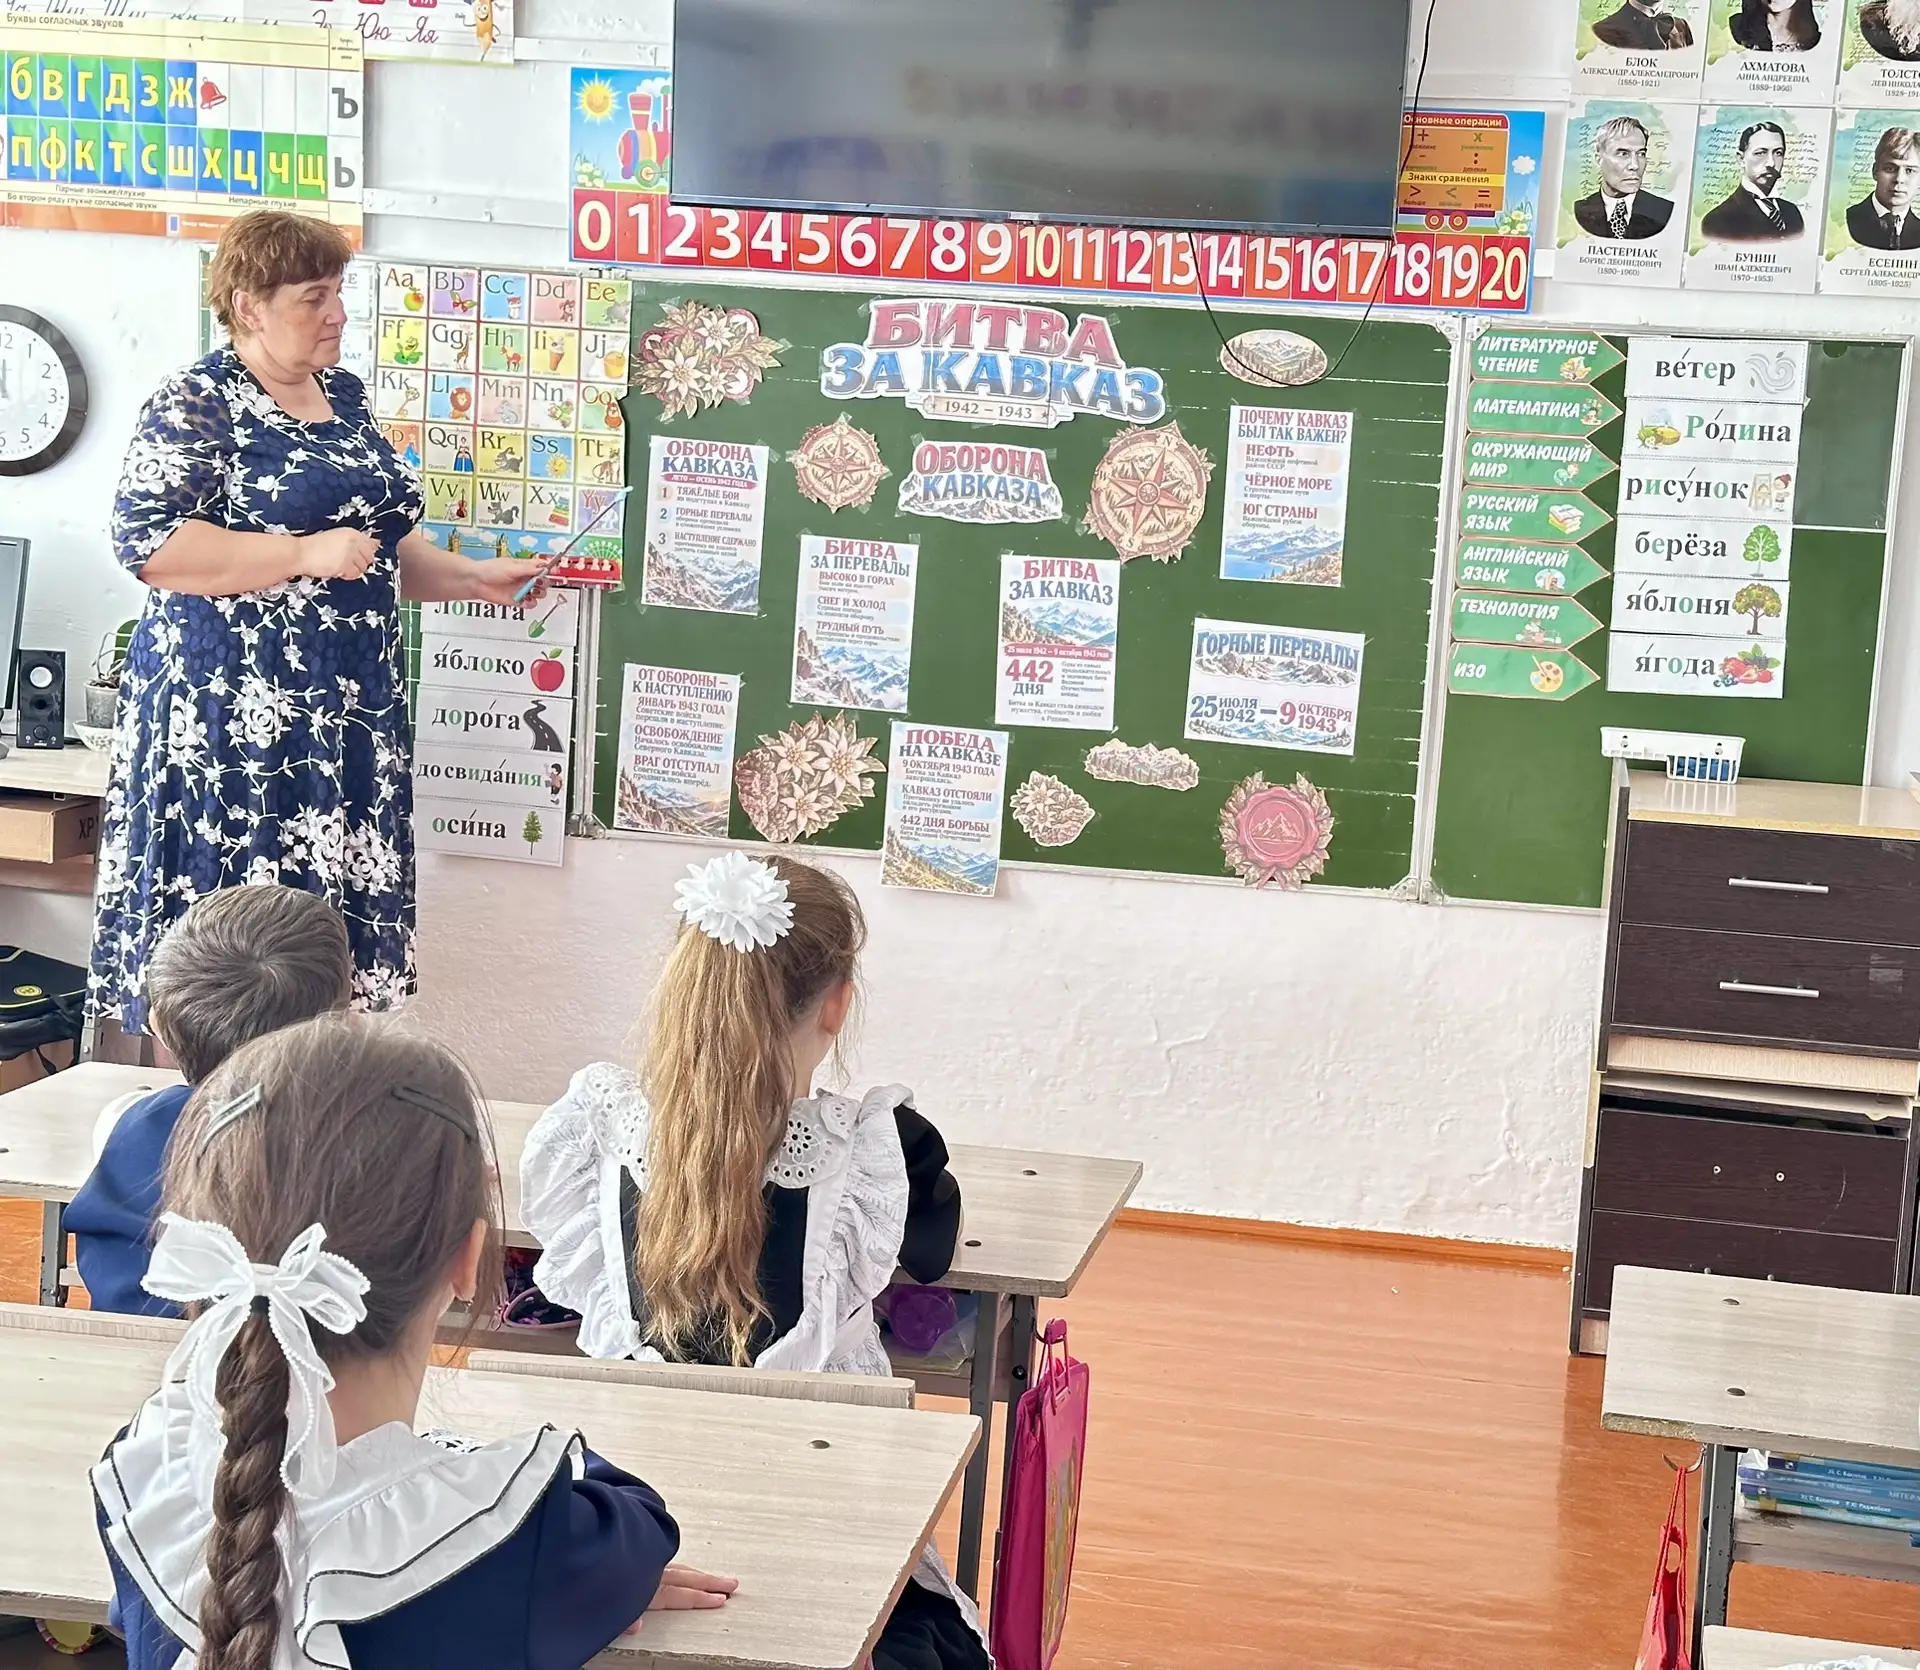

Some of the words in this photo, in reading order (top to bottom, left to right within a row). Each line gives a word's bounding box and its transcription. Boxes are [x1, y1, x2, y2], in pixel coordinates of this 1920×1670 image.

[7, 13, 37, 24] Буквы
[38, 15, 89, 26] согласных
[90, 18, 124, 30] звуков
[354, 12, 392, 40] Юю
[406, 15, 440, 45] Яя
[1624, 56, 1658, 68] БЛОК
[1739, 61, 1806, 74] АХМАТОВА
[1581, 68, 1628, 78] АЛЕКСАНДР
[1628, 69, 1700, 81] АЛЕКСАНДРОВИЧ
[1736, 72, 1758, 81] АННА
[1758, 73, 1810, 83] АНДРЕЕВНА
[1403, 114, 1453, 126] Оновные
[1454, 118, 1502, 128] операции
[1408, 172, 1437, 182] Знаки
[1438, 174, 1490, 184] сравнения
[577, 200, 612, 252] 0
[627, 202, 650, 255] 1
[664, 205, 698, 257] 2
[708, 208, 741, 260] 3
[750, 212, 788, 263] 4
[797, 213, 831, 265] 5
[839, 214, 877, 268] 6
[886, 218, 921, 271] 7
[929, 220, 967, 273] 8
[976, 221, 1013, 275] 9
[1019, 225, 1060, 279] 10
[1065, 228, 1103, 282] 11
[1110, 229, 1154, 285] 12
[1156, 231, 1198, 287] 13
[1202, 235, 1244, 289] 14
[1247, 237, 1291, 291] 15
[1295, 238, 1338, 294] 16
[1341, 240, 1388, 296] 17
[1389, 242, 1432, 298] 18
[1435, 244, 1479, 299] 19
[1481, 246, 1529, 302] 20
[1587, 244, 1658, 260] ПАСТЕРНАК
[1734, 252, 1777, 264] БУНИН
[1578, 256, 1606, 267] БОРИС
[1606, 258, 1662, 270] ЛЕОНИДОВИЧ
[1714, 263, 1738, 272] ИВАН
[1738, 264, 1792, 275] АЛЕКСЕЕВИЧ
[1839, 266, 1870, 278] СЕРГЕЙ
[1868, 257, 1918, 270] ЕСЕНИН
[867, 301, 1122, 368] БИТВА
[1477, 336, 1599, 355] ЛИТЕРАТУРНОЕ
[1478, 356, 1540, 373] ЧТЕНИЕ
[825, 347, 910, 396] ЗА
[917, 350, 1164, 421] КАВКАЗ
[944, 400, 980, 415] 1942
[998, 404, 1033, 420] 1943
[1473, 397, 1580, 419] МАТЕМАТИКА
[1238, 409, 1294, 426] ПОЧЕМУ
[1297, 412, 1348, 429] КАВКАЗ
[1237, 424, 1266, 439] БЫЛ
[1268, 426, 1294, 441] ТАК
[1296, 428, 1347, 444] ВАЖЕН?
[666, 440, 754, 463] ОБОРОНА
[1245, 443, 1295, 458] НЕФТЬ
[1471, 442, 1593, 463] ОКРУЖАЮЩИЙ
[661, 456, 759, 482] КАВКАЗА
[915, 443, 1049, 485] ОБОРОНА
[1469, 462, 1508, 478] МИР
[1245, 471, 1296, 489] ЧЁРНОЕ
[1297, 477, 1333, 491] МОРЕ
[662, 487, 668, 498] 1
[676, 486, 720, 499] ТЯЖЁЛЫЕ
[722, 490, 740, 500] БОИ
[922, 473, 1042, 509] КАВКАЗА
[1242, 503, 1263, 515] ЮГ
[1264, 504, 1318, 519] СТРАНЫ
[1466, 494, 1540, 514] РУССКИЙ
[660, 508, 668, 519] 2
[675, 507, 709, 517] ГОРНЫЕ
[710, 510, 753, 522] ПЕРЕВАЛЫ
[1464, 514, 1513, 532] ЯЗЫК
[658, 532, 666, 545] 3
[674, 531, 721, 544] НАСТУПЛЕНИЕ
[722, 536, 757, 547] СДЕРЖАНО
[1634, 531, 1728, 562] берёза
[824, 539, 898, 561] БИТВА
[1463, 545, 1570, 568] АНГЛИЙСКИЙ
[810, 555, 830, 569] ЗА
[833, 555, 910, 577] ПЕРЕВАЛЫ
[1023, 559, 1100, 584] БИТВА
[1461, 566, 1510, 584] ЯЗЫК
[819, 571, 857, 583] ВЫСОКО
[859, 574, 866, 583] В
[867, 575, 895, 586] ГОРАХ
[1009, 580, 1035, 601] ЗА
[1039, 580, 1113, 606] КАВКАЗ
[434, 599, 525, 622] лопата
[817, 595, 840, 606] СНЕГ
[842, 597, 850, 606] И
[852, 598, 886, 612] ХОЛОД
[1459, 598, 1560, 620] ТЕХНОЛОГИЯ
[816, 620, 860, 633] ТРУДНЫЙ
[861, 625, 885, 635] ПУТЬ
[1195, 631, 1267, 658] ГОРНЫЕ
[1269, 634, 1360, 673] ПЕРЕВАЛЫ
[638, 668, 656, 681] ОТ
[657, 670, 718, 688] ОБОРОНЫ
[1005, 658, 1054, 683] 442
[1453, 662, 1487, 679] ИЗО
[632, 681, 642, 693] К
[645, 681, 733, 703] НАСТУПЛЕНИЮ
[1012, 682, 1044, 697] ДНЯ
[638, 696, 677, 709] ЯНВАРЬ
[678, 700, 699, 711] 1943
[701, 703, 725, 715] ГОДА
[1189, 695, 1218, 718] 25
[1218, 697, 1258, 710] ИЮЛЯ
[1299, 702, 1353, 723] ОКТЯБРЯ
[1219, 708, 1256, 723] 1942
[1279, 701, 1297, 726] 9
[1299, 715, 1337, 734] 1943
[634, 724, 723, 745] ОСВОБОЖДЕНИЕ
[906, 729, 995, 753] ПОБЕДА
[634, 754, 661, 766] ВРАГ
[662, 758, 720, 774] ОТСТУПАЛ
[899, 745, 923, 757] НА
[927, 745, 1002, 767] КАВКАЗЕ
[416, 763, 441, 779] до
[902, 760, 909, 768] 9
[909, 760, 951, 772] ОКТЯБРЯ
[952, 763, 972, 774] 1943
[973, 766, 996, 777] ГОДА
[901, 784, 941, 797] КАВКАЗ
[943, 789, 993, 802] ОТСТОЯЛИ
[900, 814, 921, 825] 442
[922, 817, 945, 829] ДНЯ
[947, 819, 990, 833] БОРЬБЫ
